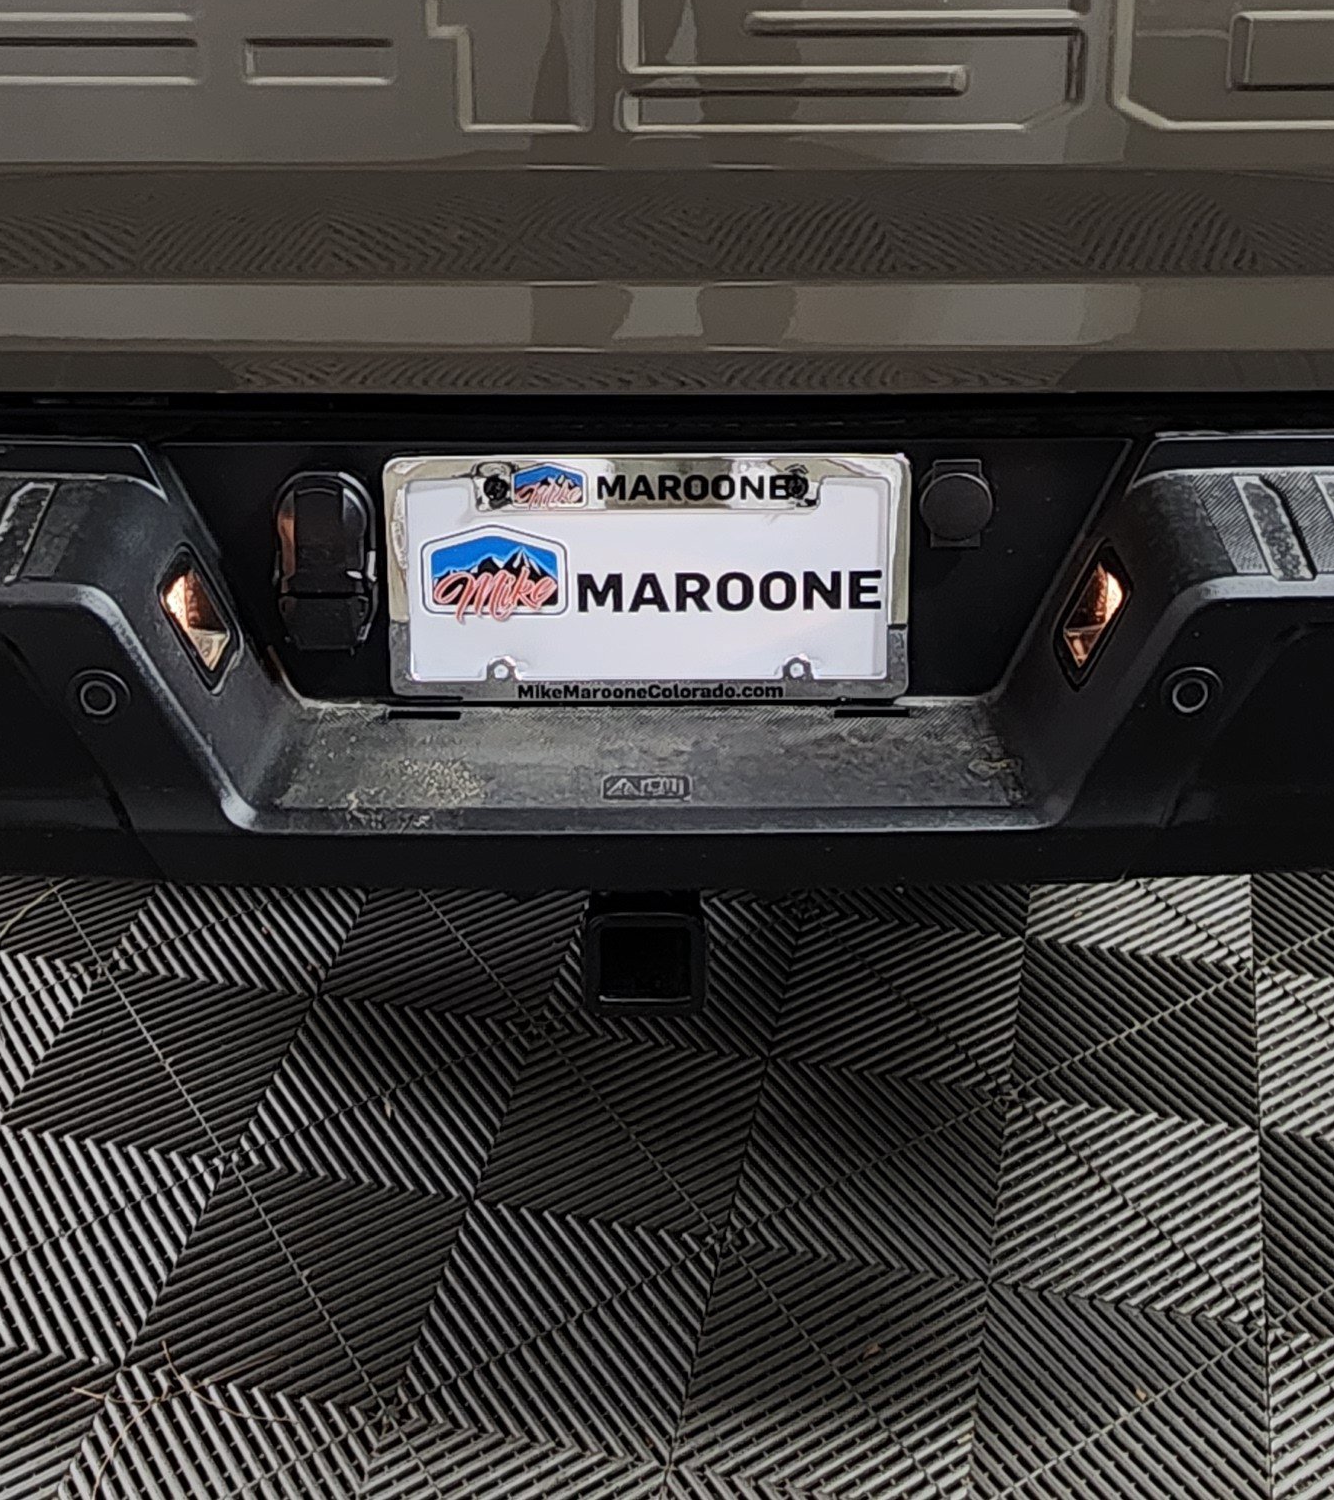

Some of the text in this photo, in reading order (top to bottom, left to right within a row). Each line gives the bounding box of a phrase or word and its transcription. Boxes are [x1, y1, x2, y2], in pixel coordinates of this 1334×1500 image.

[433, 566, 882, 624] Mike MAROONE
[517, 683, 783, 700] MikeMarooneColorado.com
